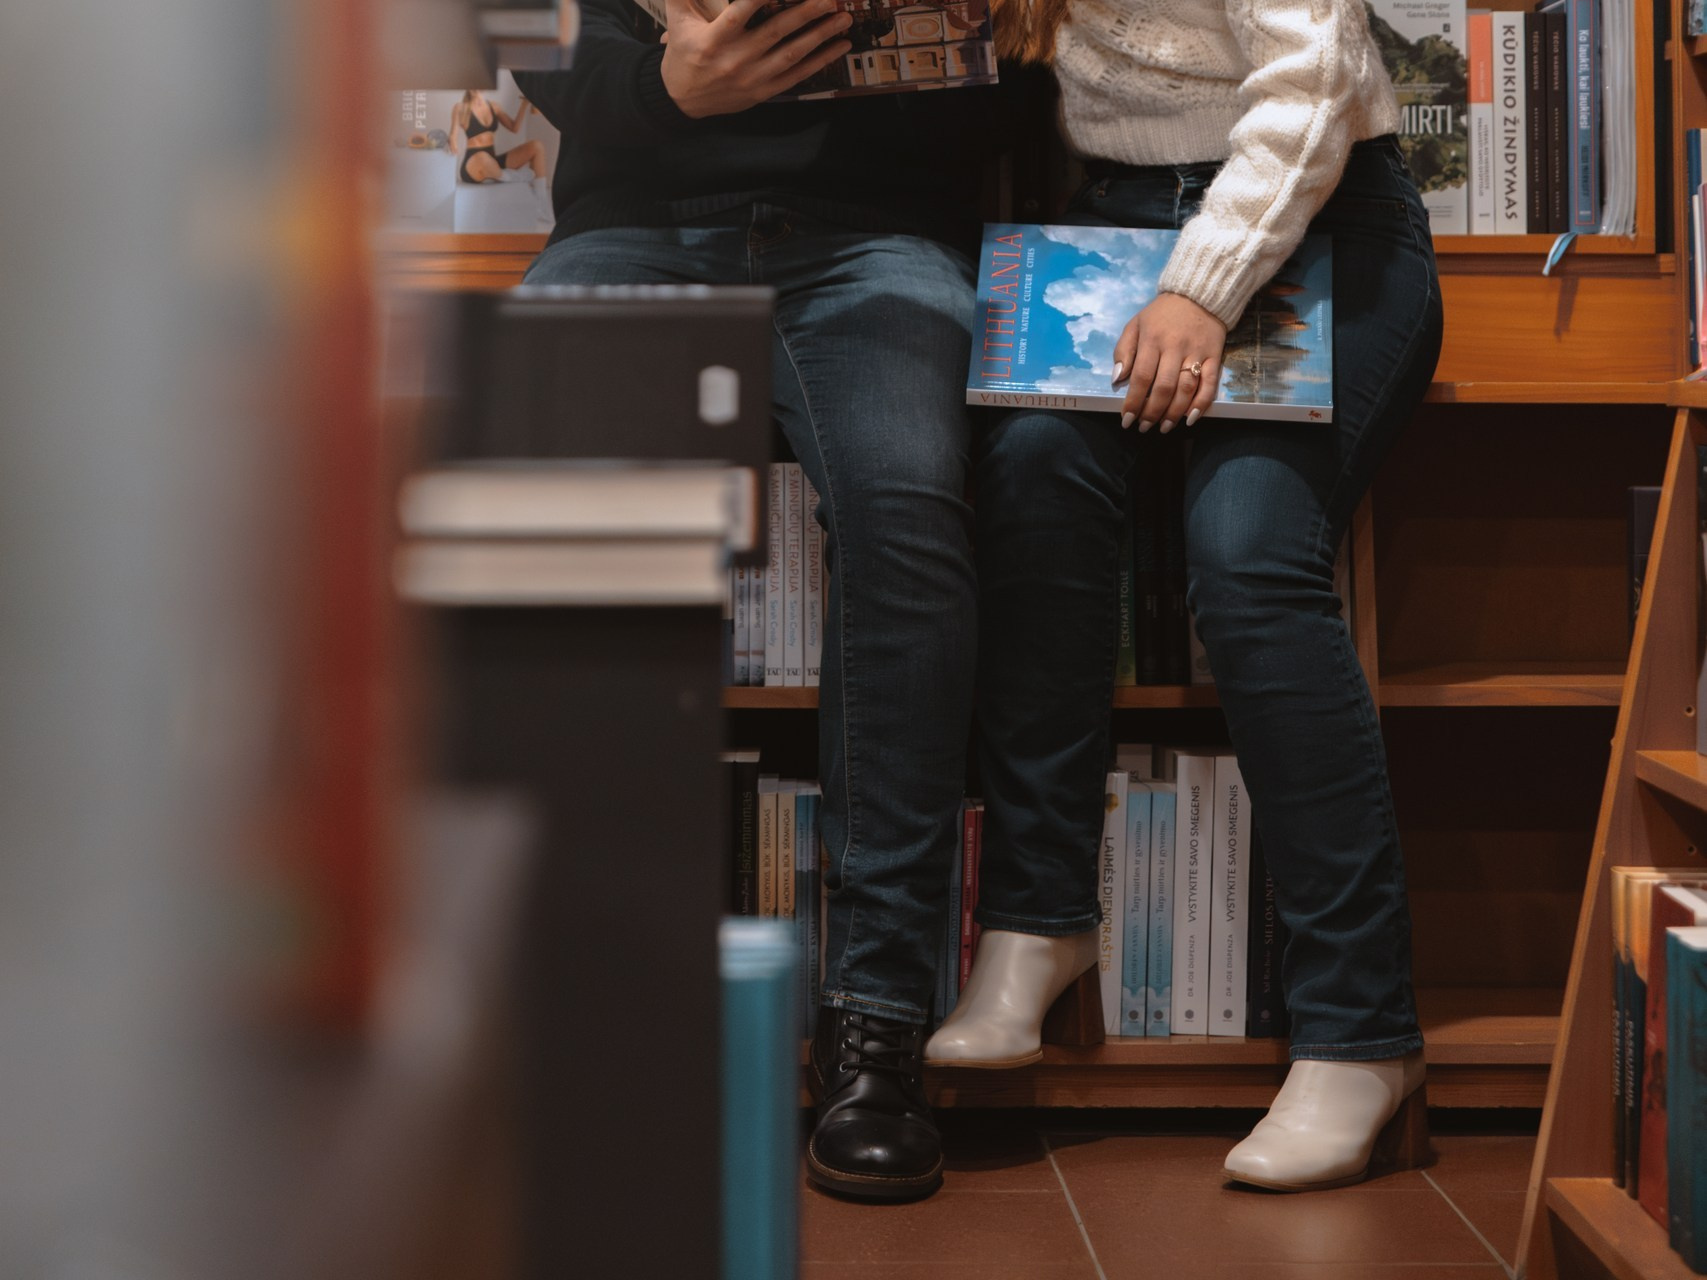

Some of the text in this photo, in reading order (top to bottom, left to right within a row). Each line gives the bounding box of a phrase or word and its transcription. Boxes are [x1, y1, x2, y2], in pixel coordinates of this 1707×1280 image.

[1578, 30, 1591, 129] Ko laukti, kai laukiesi
[1398, 105, 1452, 135] MIRTI
[1503, 25, 1520, 220] KŪDIKIO ŽINDYMAS
[982, 233, 1023, 379] LITHUANIA
[1018, 247, 1035, 365] HISTORY NATURE CULTURE CITIES
[980, 393, 1078, 408] LITHUANIA
[768, 479, 782, 533] MINUČIŲ
[787, 479, 802, 533] MINUČIŲ
[769, 537, 780, 593] TERAPIJA
[789, 536, 800, 593] TERAPIJA
[808, 537, 820, 592] TERAPIJA
[768, 600, 778, 646] Sarah Crosby
[788, 600, 799, 646] Sarah Crosby
[808, 600, 818, 646] Sarah Crosby
[763, 809, 771, 849] SĖKMINGAS
[782, 809, 791, 849] SĖKMINGAS
[1134, 821, 1143, 857] gyvenimo
[1159, 821, 1168, 857] gyvenimo
[1189, 785, 1200, 923] VYSTYKITE SAVO SMEGENIS
[1227, 785, 1238, 923] VYSTYKITE SAVO SMEGENIS
[1101, 837, 1116, 972] LAIMĖS DIENORAŠTIS
[1133, 896, 1141, 913] Tarp
[1157, 896, 1166, 913] Tarp
[1263, 904, 1273, 944] SIELOS
